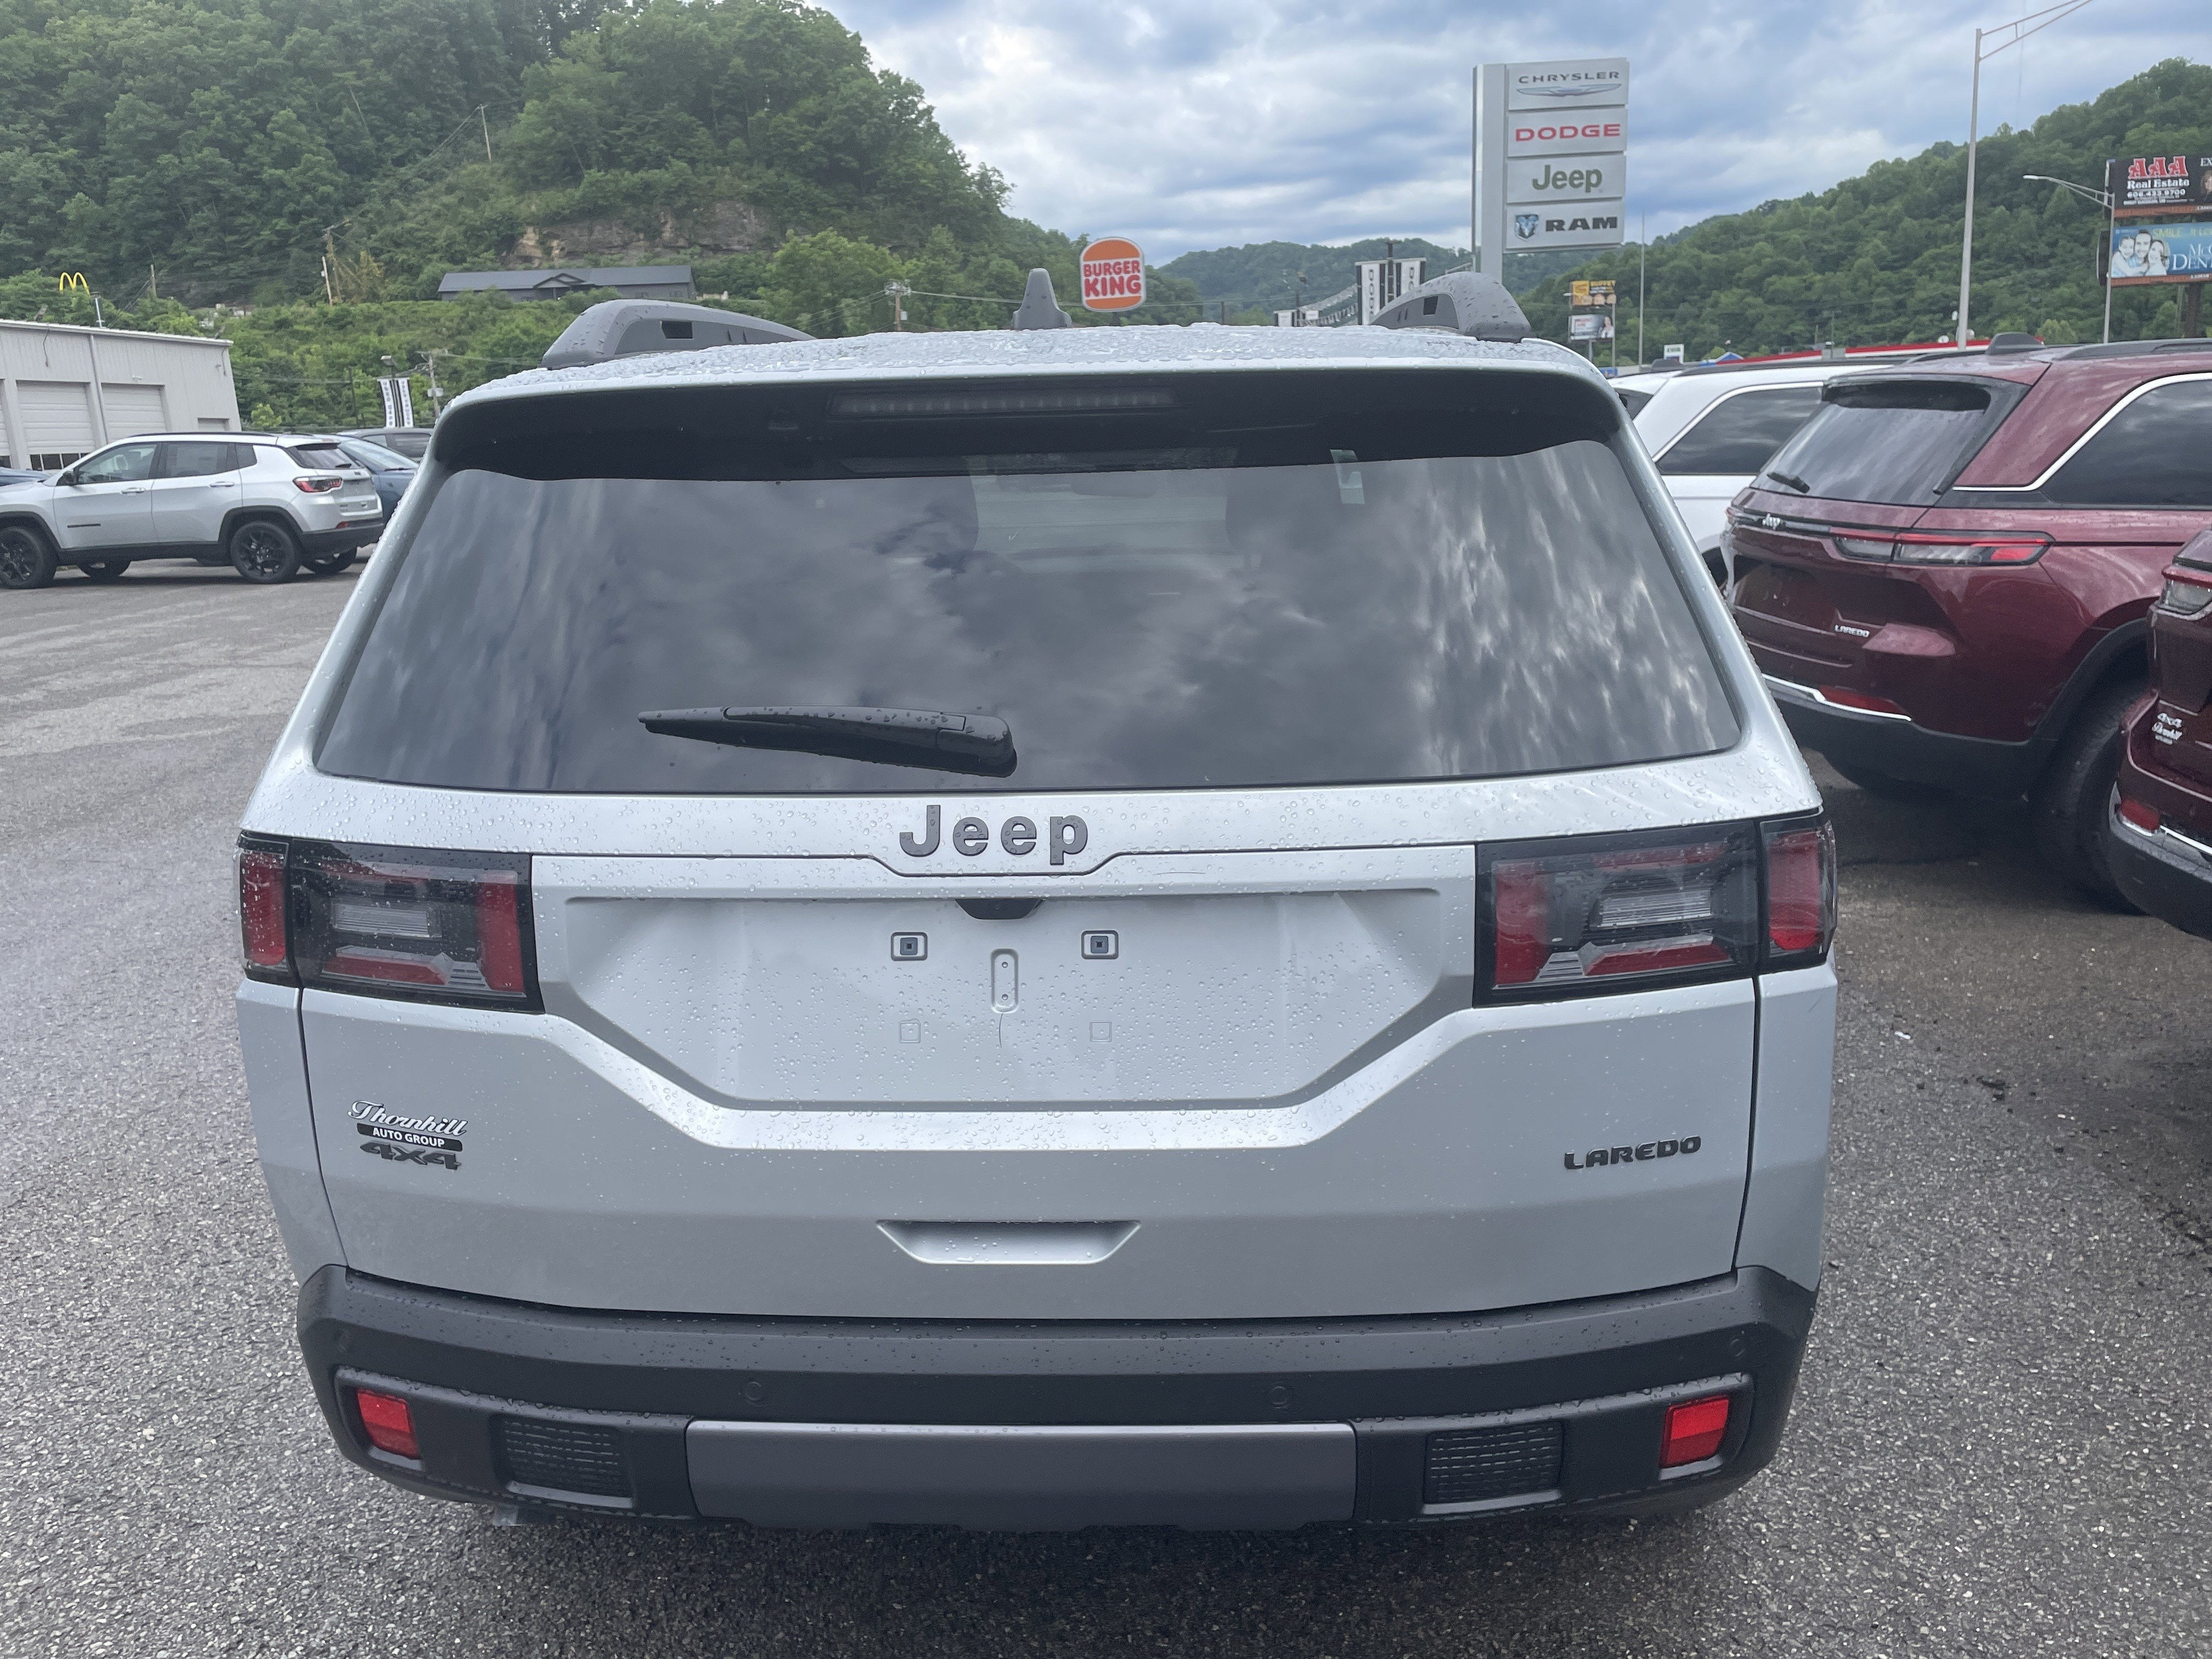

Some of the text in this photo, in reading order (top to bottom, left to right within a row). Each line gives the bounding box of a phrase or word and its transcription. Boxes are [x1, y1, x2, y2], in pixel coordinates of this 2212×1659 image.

[1518, 71, 1621, 83] CHRYSLER
[1515, 123, 1621, 142] DODGE
[2128, 155, 2189, 180] AAA
[1532, 165, 1602, 193] Jeep
[2127, 178, 2190, 190] Real Estate
[1545, 216, 1618, 232] RAM
[1083, 260, 1141, 278] BURGER
[2172, 253, 2212, 270] DEN
[1085, 275, 1142, 297] KING
[899, 804, 1088, 866] Jeep
[347, 1099, 468, 1136] Thornhill
[373, 1127, 445, 1148] AUTO GROUP
[1564, 1136, 1701, 1170] LAREDO
